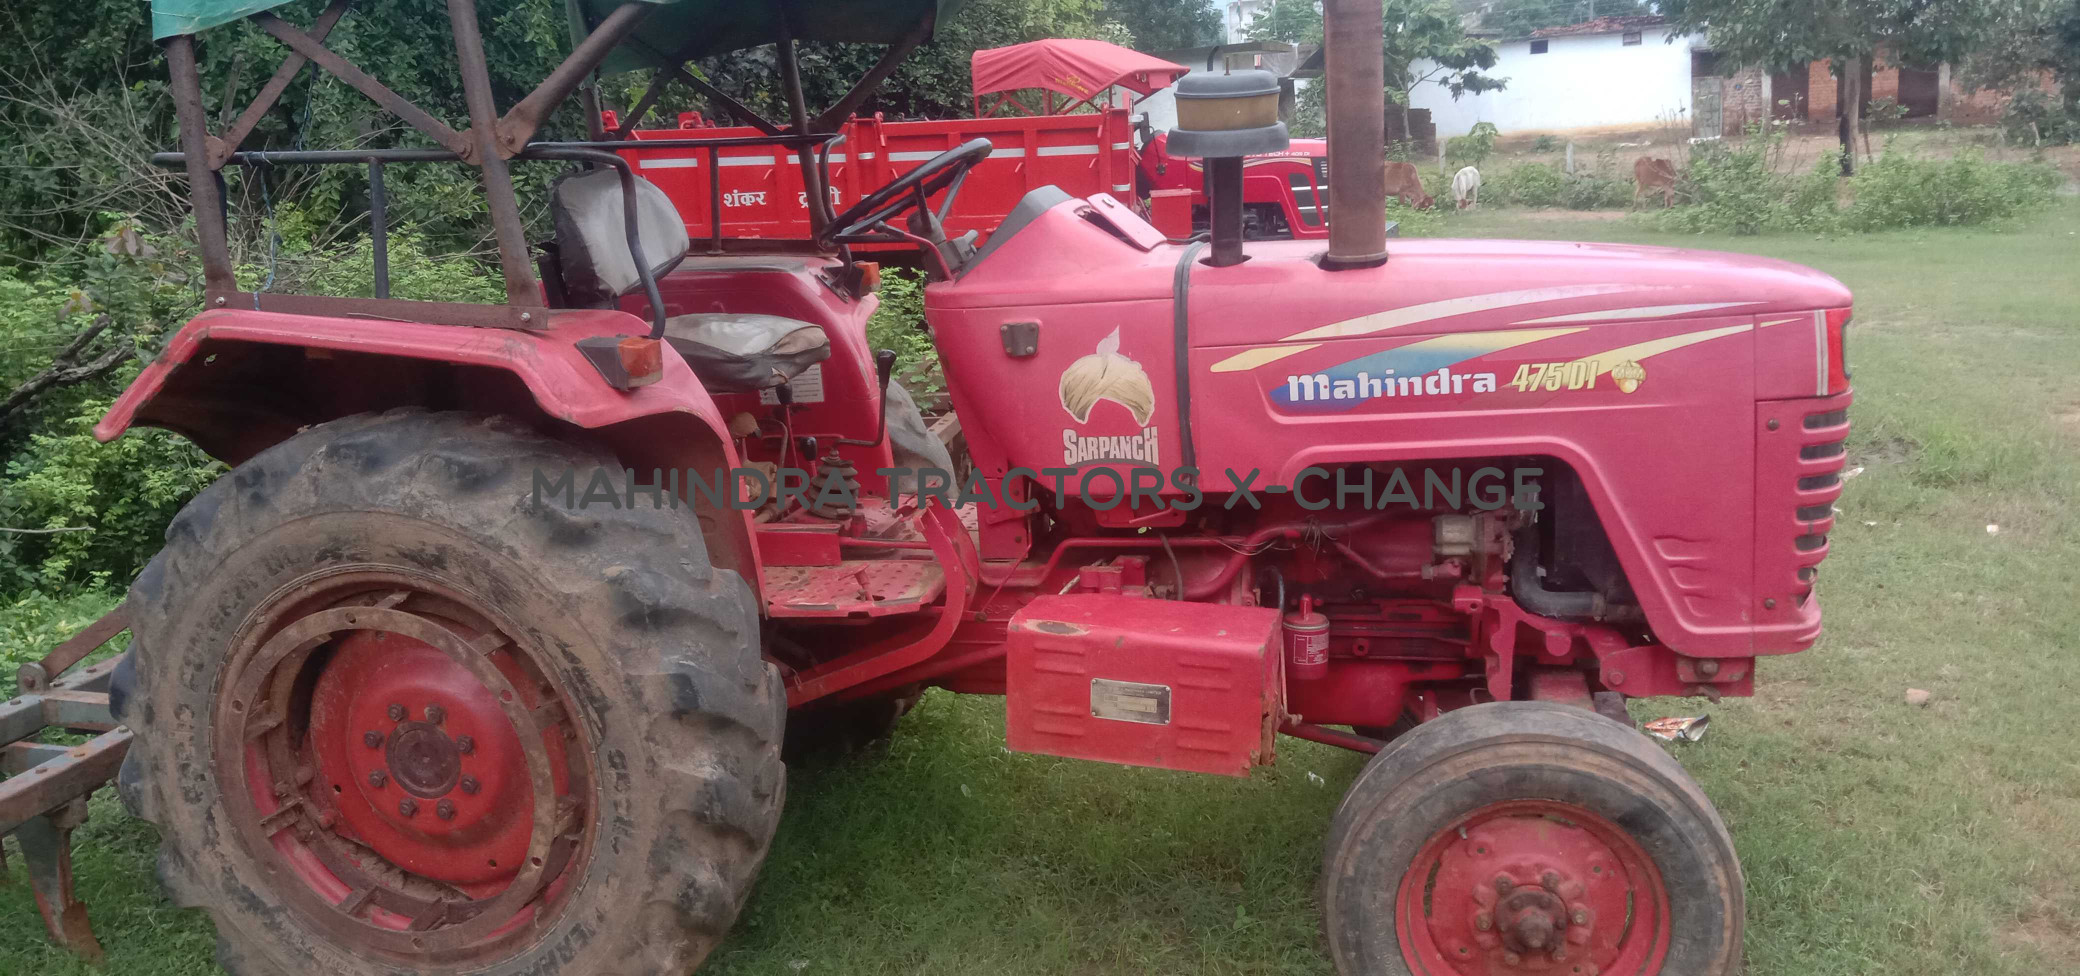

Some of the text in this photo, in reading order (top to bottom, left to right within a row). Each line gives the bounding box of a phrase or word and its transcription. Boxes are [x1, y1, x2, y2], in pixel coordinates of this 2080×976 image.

[723, 189, 767, 208] शंकर
[1286, 366, 1497, 402] Mahindra
[1511, 362, 1566, 393] 475
[1567, 360, 1599, 391] DI
[1062, 426, 1160, 466] SARPANCH
